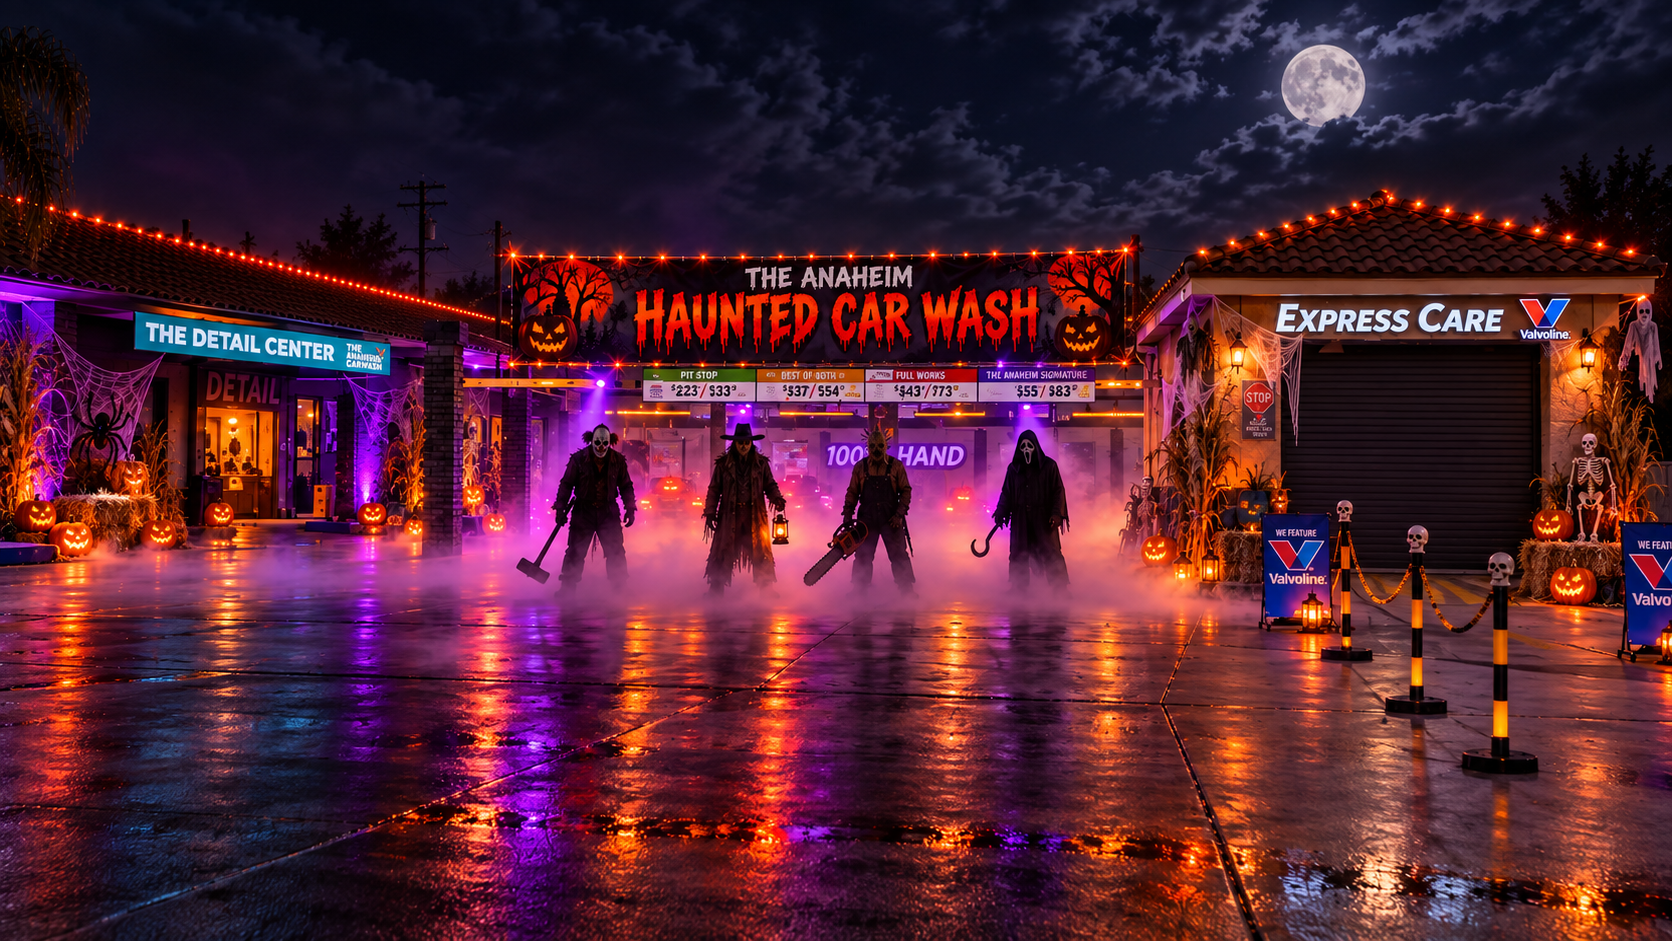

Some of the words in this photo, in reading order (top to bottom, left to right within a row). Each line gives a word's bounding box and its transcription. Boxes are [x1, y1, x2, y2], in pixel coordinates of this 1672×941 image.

[745, 266, 793, 290] THE
[800, 265, 913, 289] ANAHEIM
[633, 288, 820, 355] HAUNTED
[831, 291, 912, 354] CAR
[921, 285, 1040, 354] WASH
[1276, 303, 1410, 333] EXPRESS
[1418, 303, 1504, 333] CARE
[145, 321, 187, 346] THE
[192, 328, 261, 354] DETAIL
[264, 337, 334, 361] CENTER
[680, 371, 694, 379] PIT
[696, 371, 718, 379] STOP
[896, 371, 914, 379] FULL
[206, 371, 280, 404] DETAIL
[1246, 392, 1271, 403] STOP
[827, 445, 869, 466] 100
[898, 445, 965, 466] HAND
[1275, 529, 1286, 537] WE
[1287, 529, 1317, 537] FEATURE
[1637, 540, 1650, 550] WE
